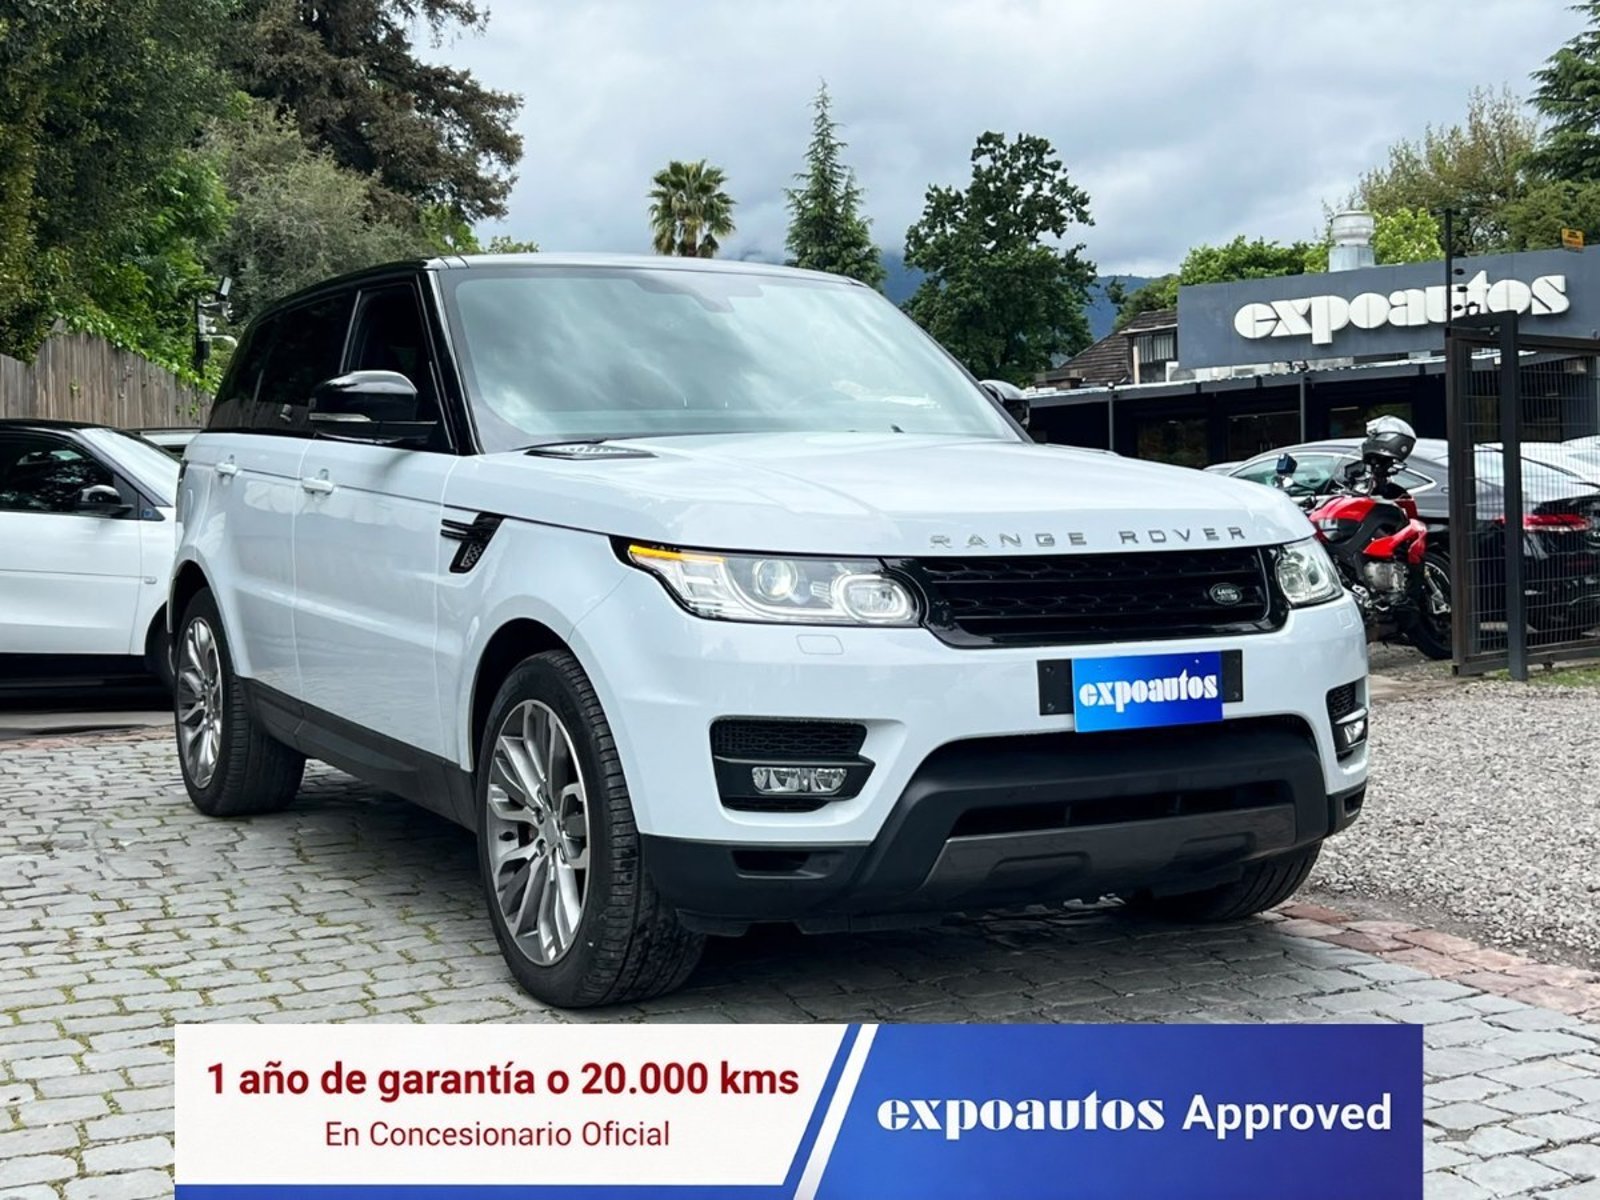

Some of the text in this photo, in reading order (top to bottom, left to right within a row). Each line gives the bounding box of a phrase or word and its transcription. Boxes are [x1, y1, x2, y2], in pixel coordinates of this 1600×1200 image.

[1234, 270, 1570, 345] expoautos
[929, 527, 1247, 549] RANGE ROVER
[1079, 669, 1218, 713] expoautos
